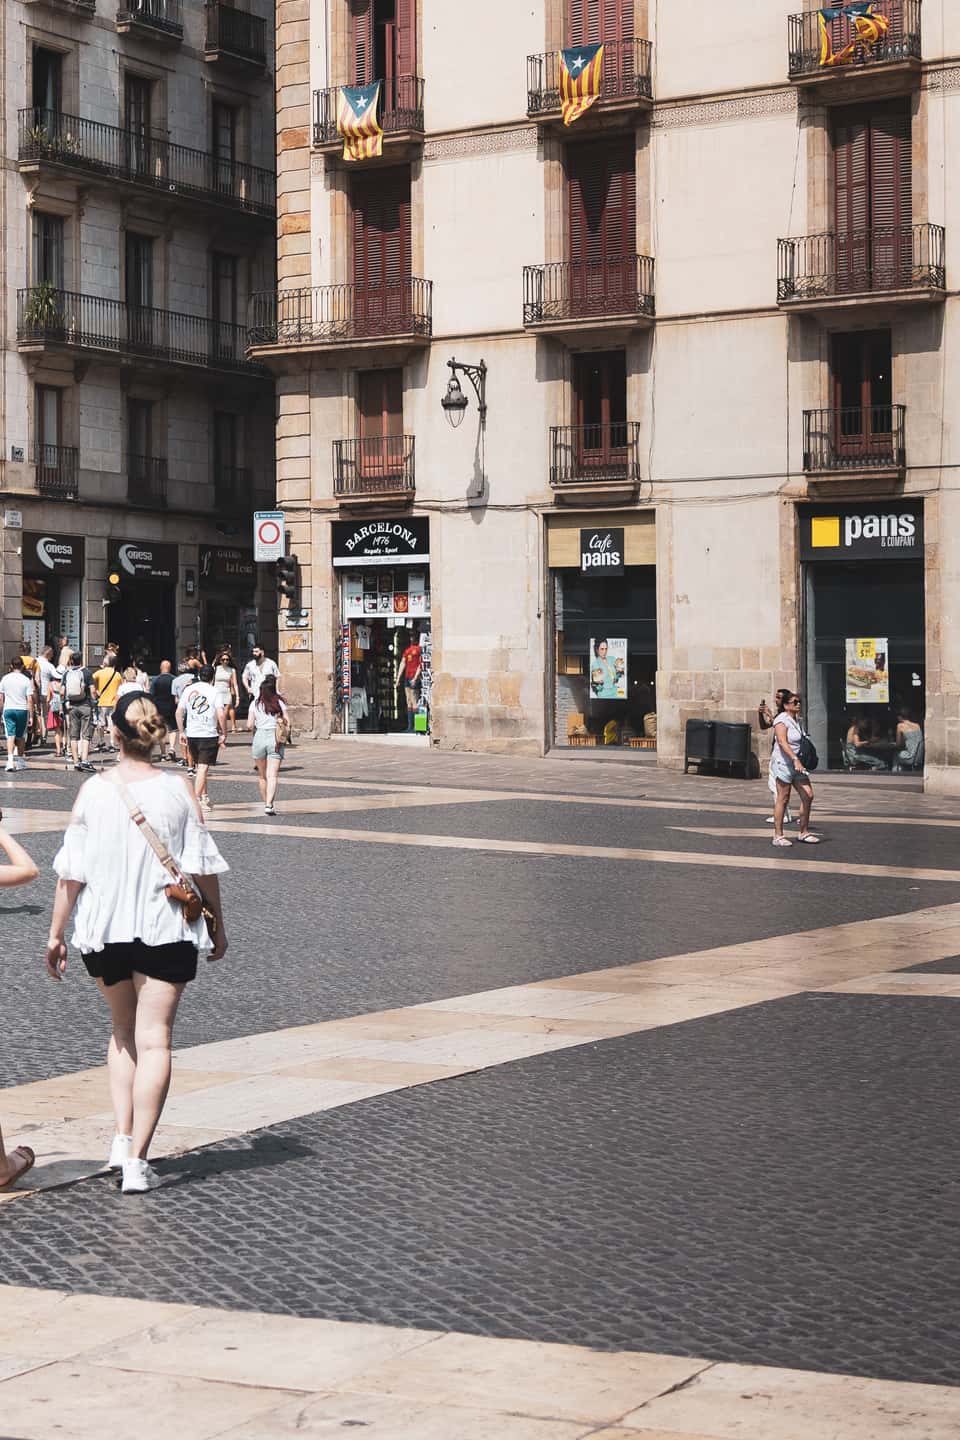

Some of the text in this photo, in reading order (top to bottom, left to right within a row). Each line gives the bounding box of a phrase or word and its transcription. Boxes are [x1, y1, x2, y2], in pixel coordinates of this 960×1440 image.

[345, 522, 418, 551] BARCELONA
[845, 514, 915, 546] pans
[887, 536, 915, 547] COMPANY
[582, 552, 621, 571] pans
